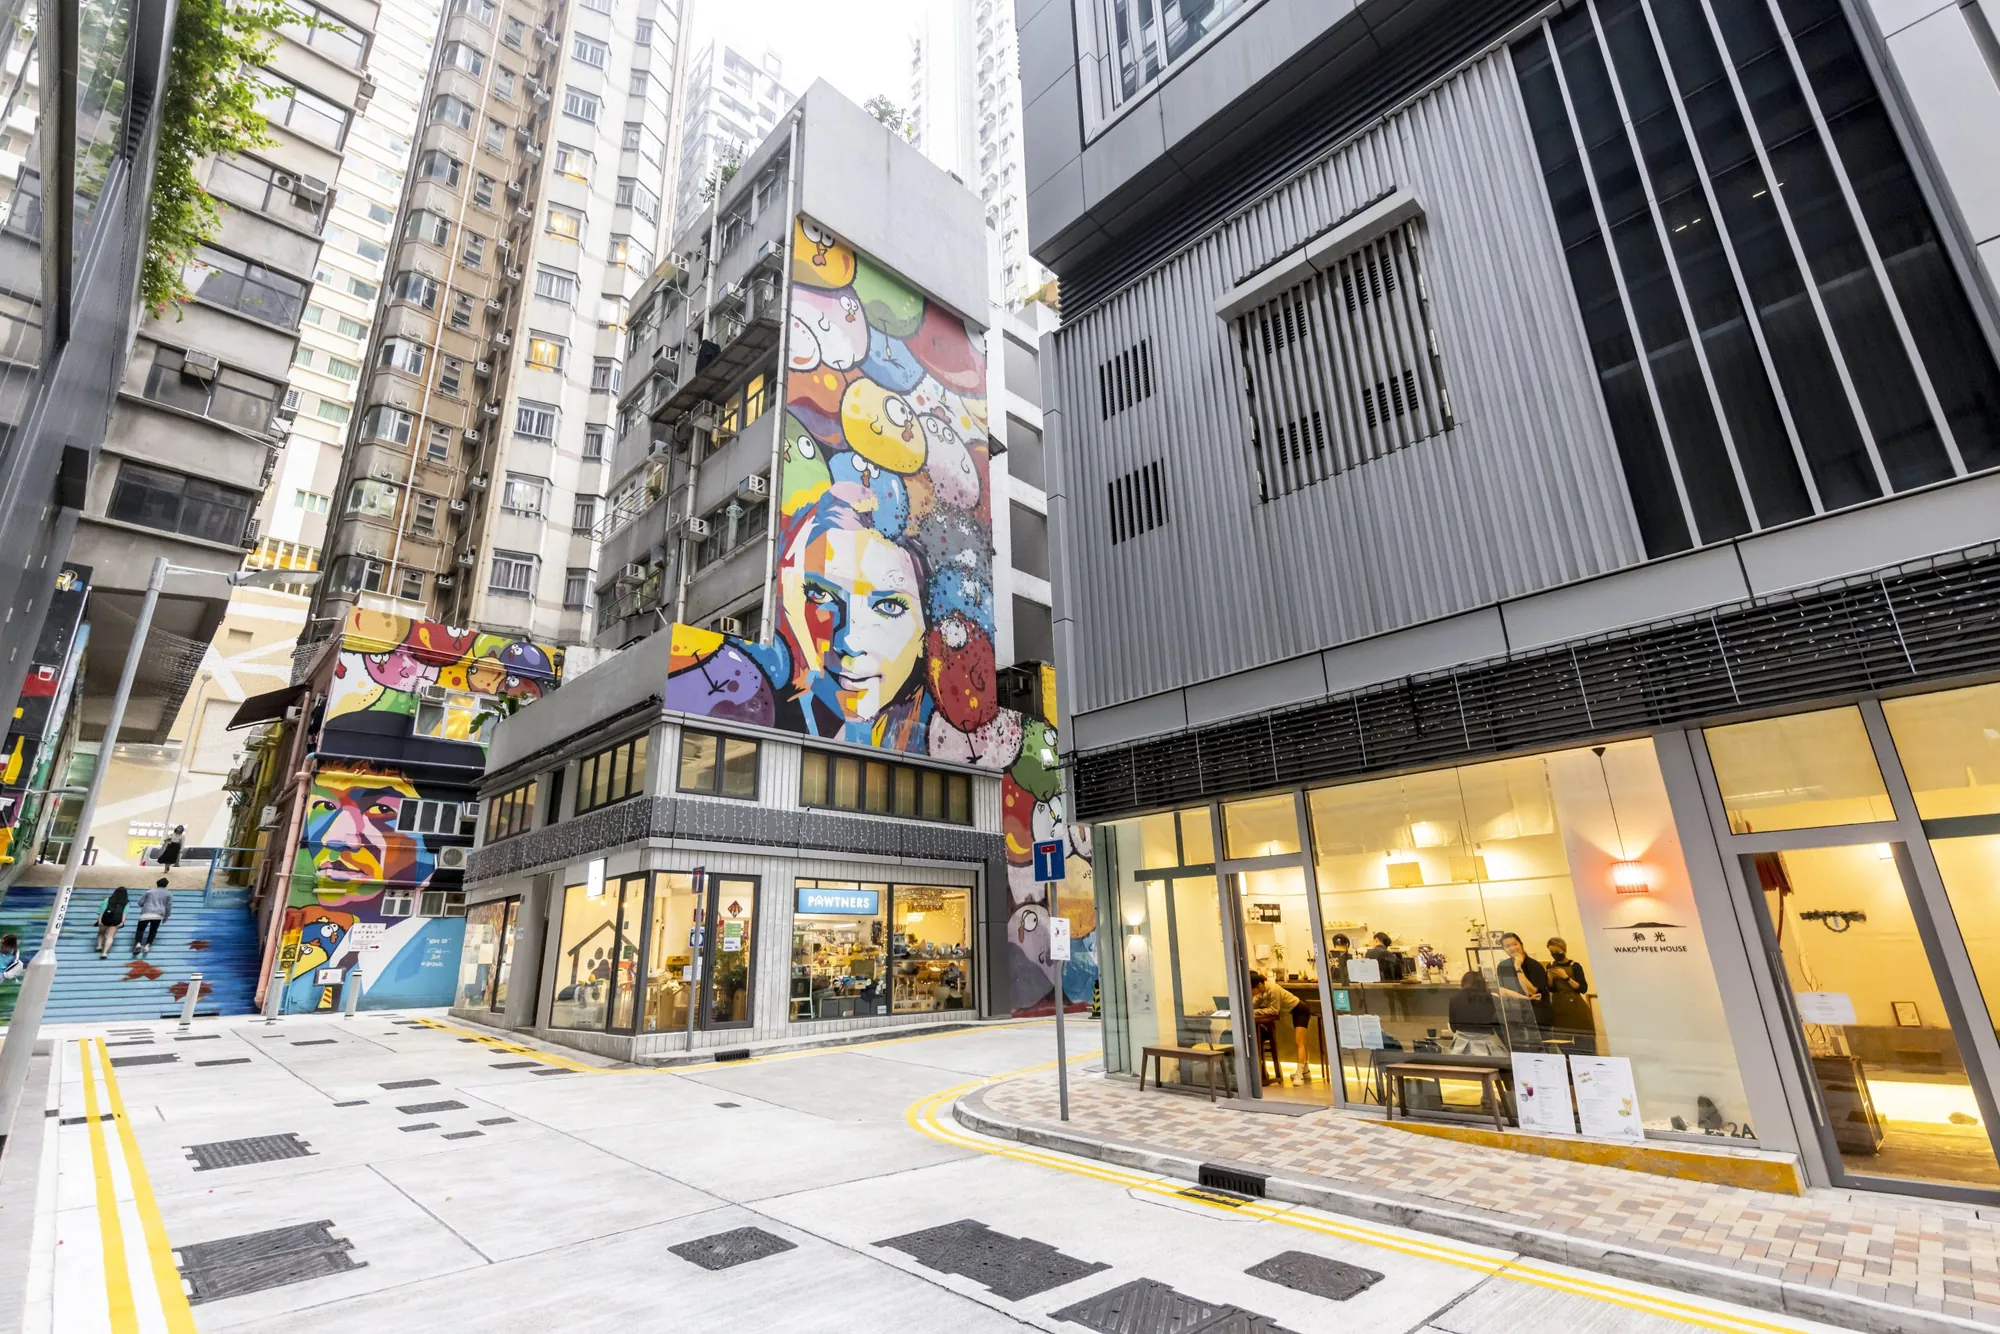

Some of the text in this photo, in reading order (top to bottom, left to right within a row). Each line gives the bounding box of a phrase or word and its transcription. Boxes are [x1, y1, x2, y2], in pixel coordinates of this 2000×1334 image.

[55, 887, 71, 929] 51550
[808, 895, 870, 909] PAWTNERS
[1660, 945, 1688, 953] HOUSE
